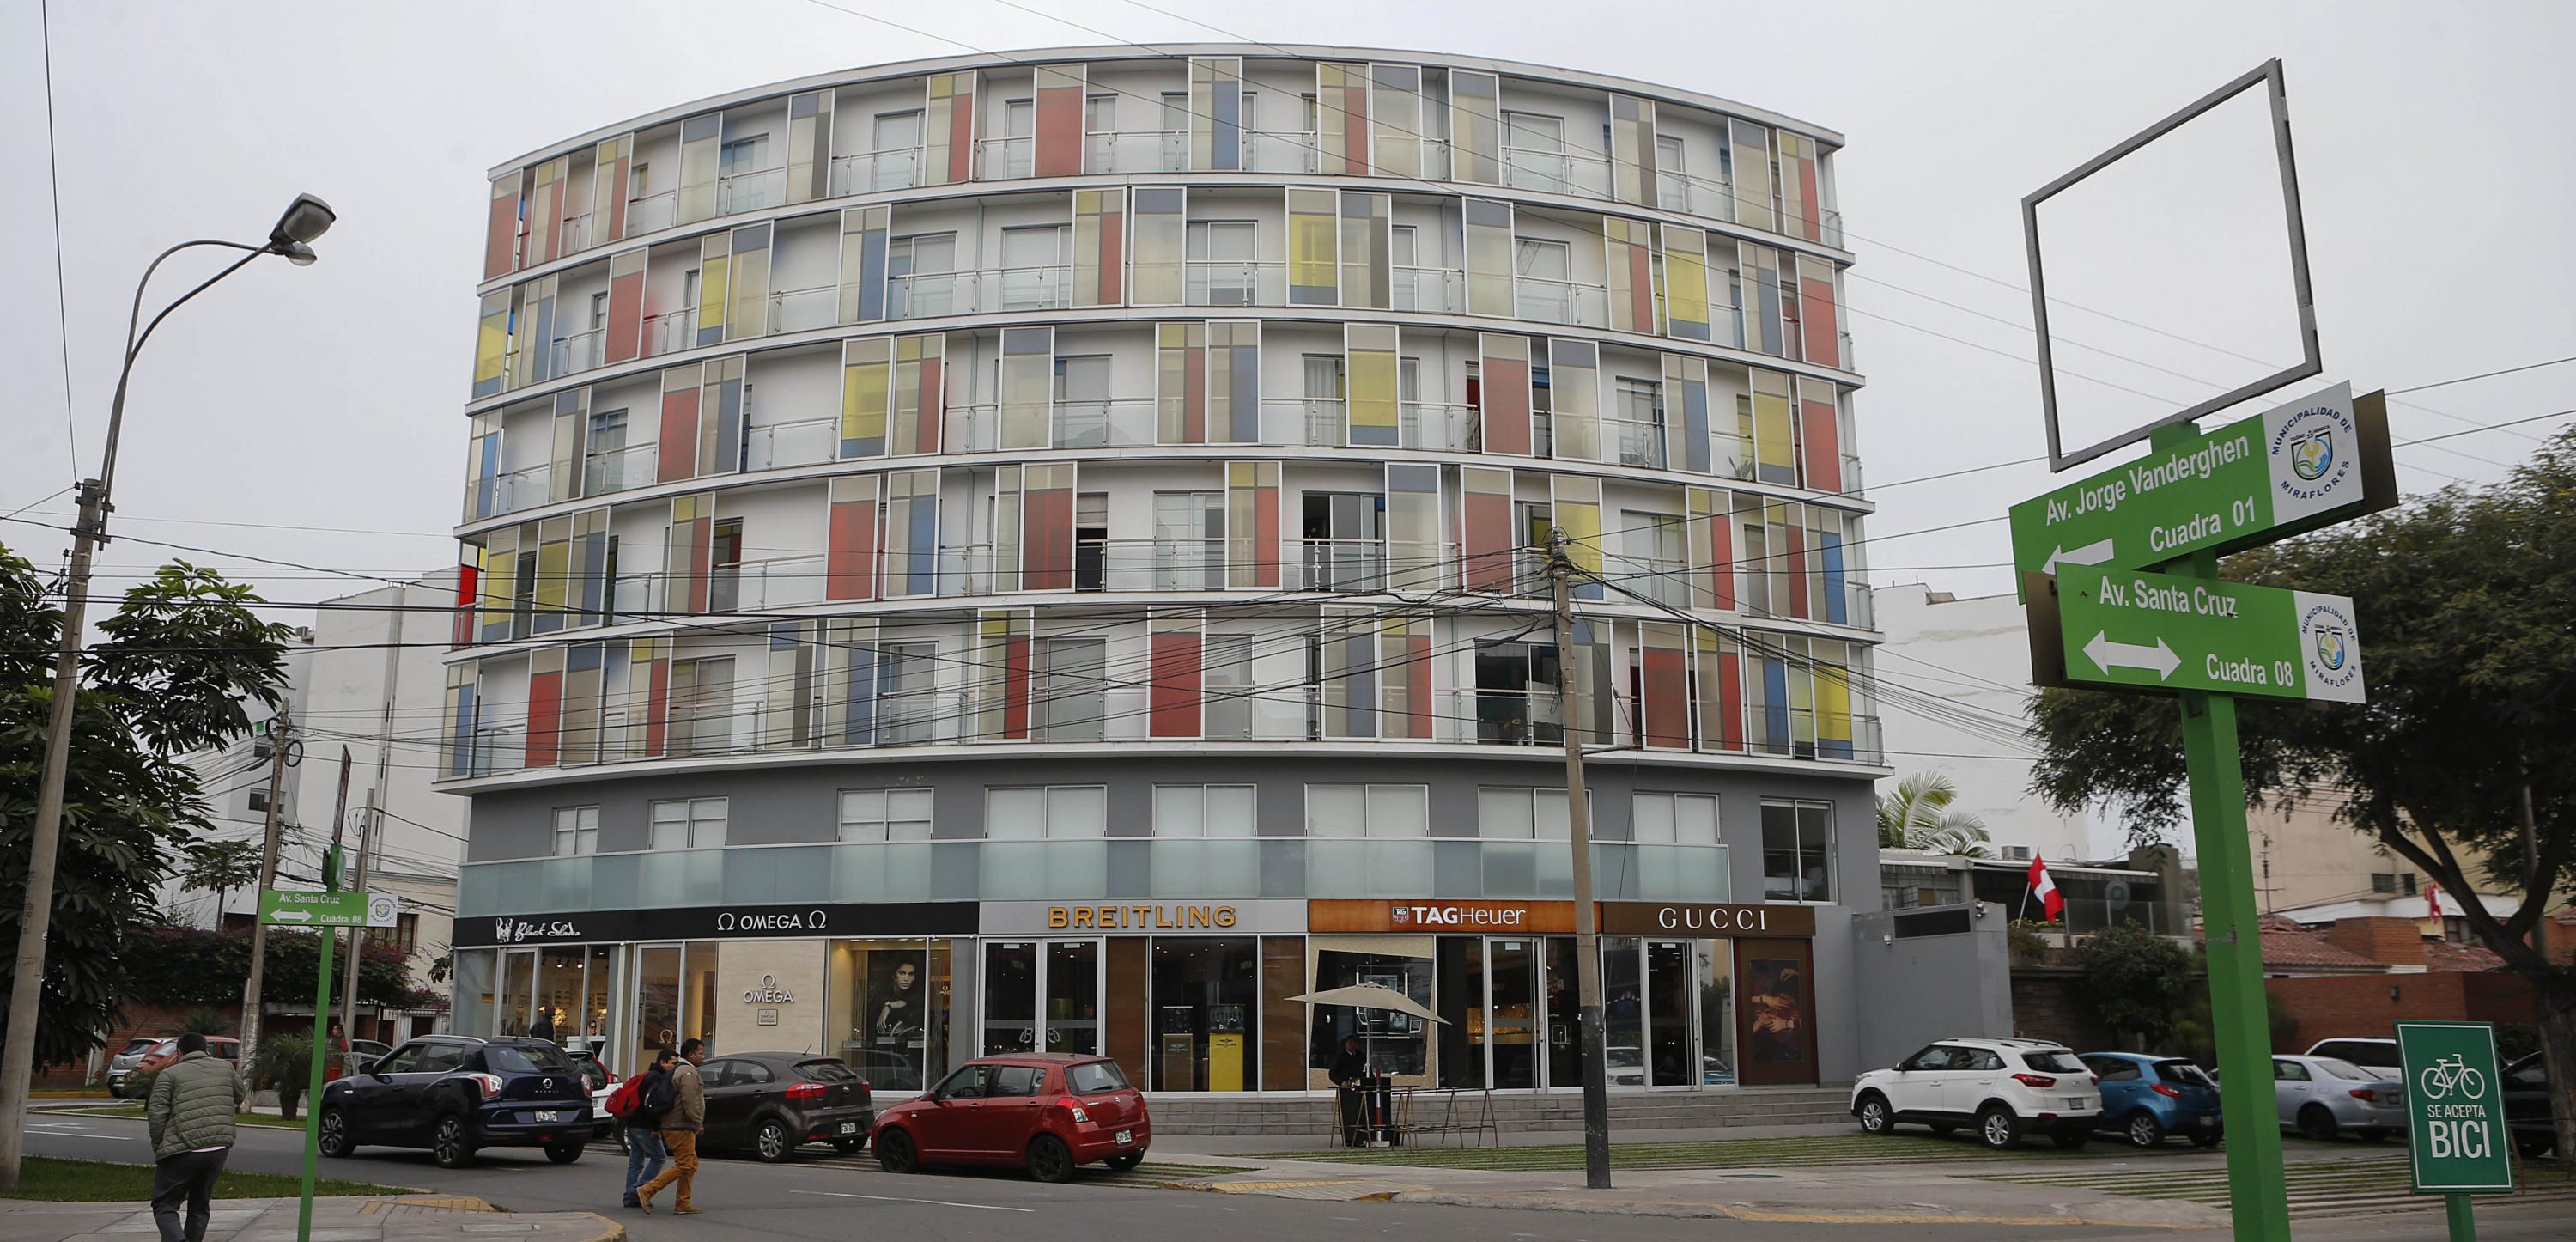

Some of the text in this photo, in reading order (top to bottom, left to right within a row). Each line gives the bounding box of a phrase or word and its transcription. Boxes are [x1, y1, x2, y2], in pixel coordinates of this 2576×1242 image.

[2272, 407, 2352, 455] MUNICIPALIDAD DE
[2046, 435, 2250, 526] Av. Jorge Vanderghen
[2281, 460, 2350, 500] MIRAFLORES
[2150, 496, 2256, 552] Cuadra 01
[2099, 575, 2239, 618] Av. Santa Cruz
[2302, 605, 2356, 642] MUNICIPALIDAD DE
[2206, 653, 2294, 687] Cuadra 08
[2309, 661, 2356, 687] MIRAFLORES
[279, 893, 340, 904] Av. Santa Cruz
[320, 914, 349, 923] Cuadra
[352, 915, 361, 923] 08
[740, 913, 803, 929] OMEGA
[1048, 906, 1236, 928] BREITLING
[1658, 907, 1766, 930] GUCCI
[515, 922, 546, 941] Black
[743, 989, 795, 1003] OMEGA
[2427, 1105, 2487, 1117] SE ACEPTA
[2429, 1120, 2492, 1159] BICI
